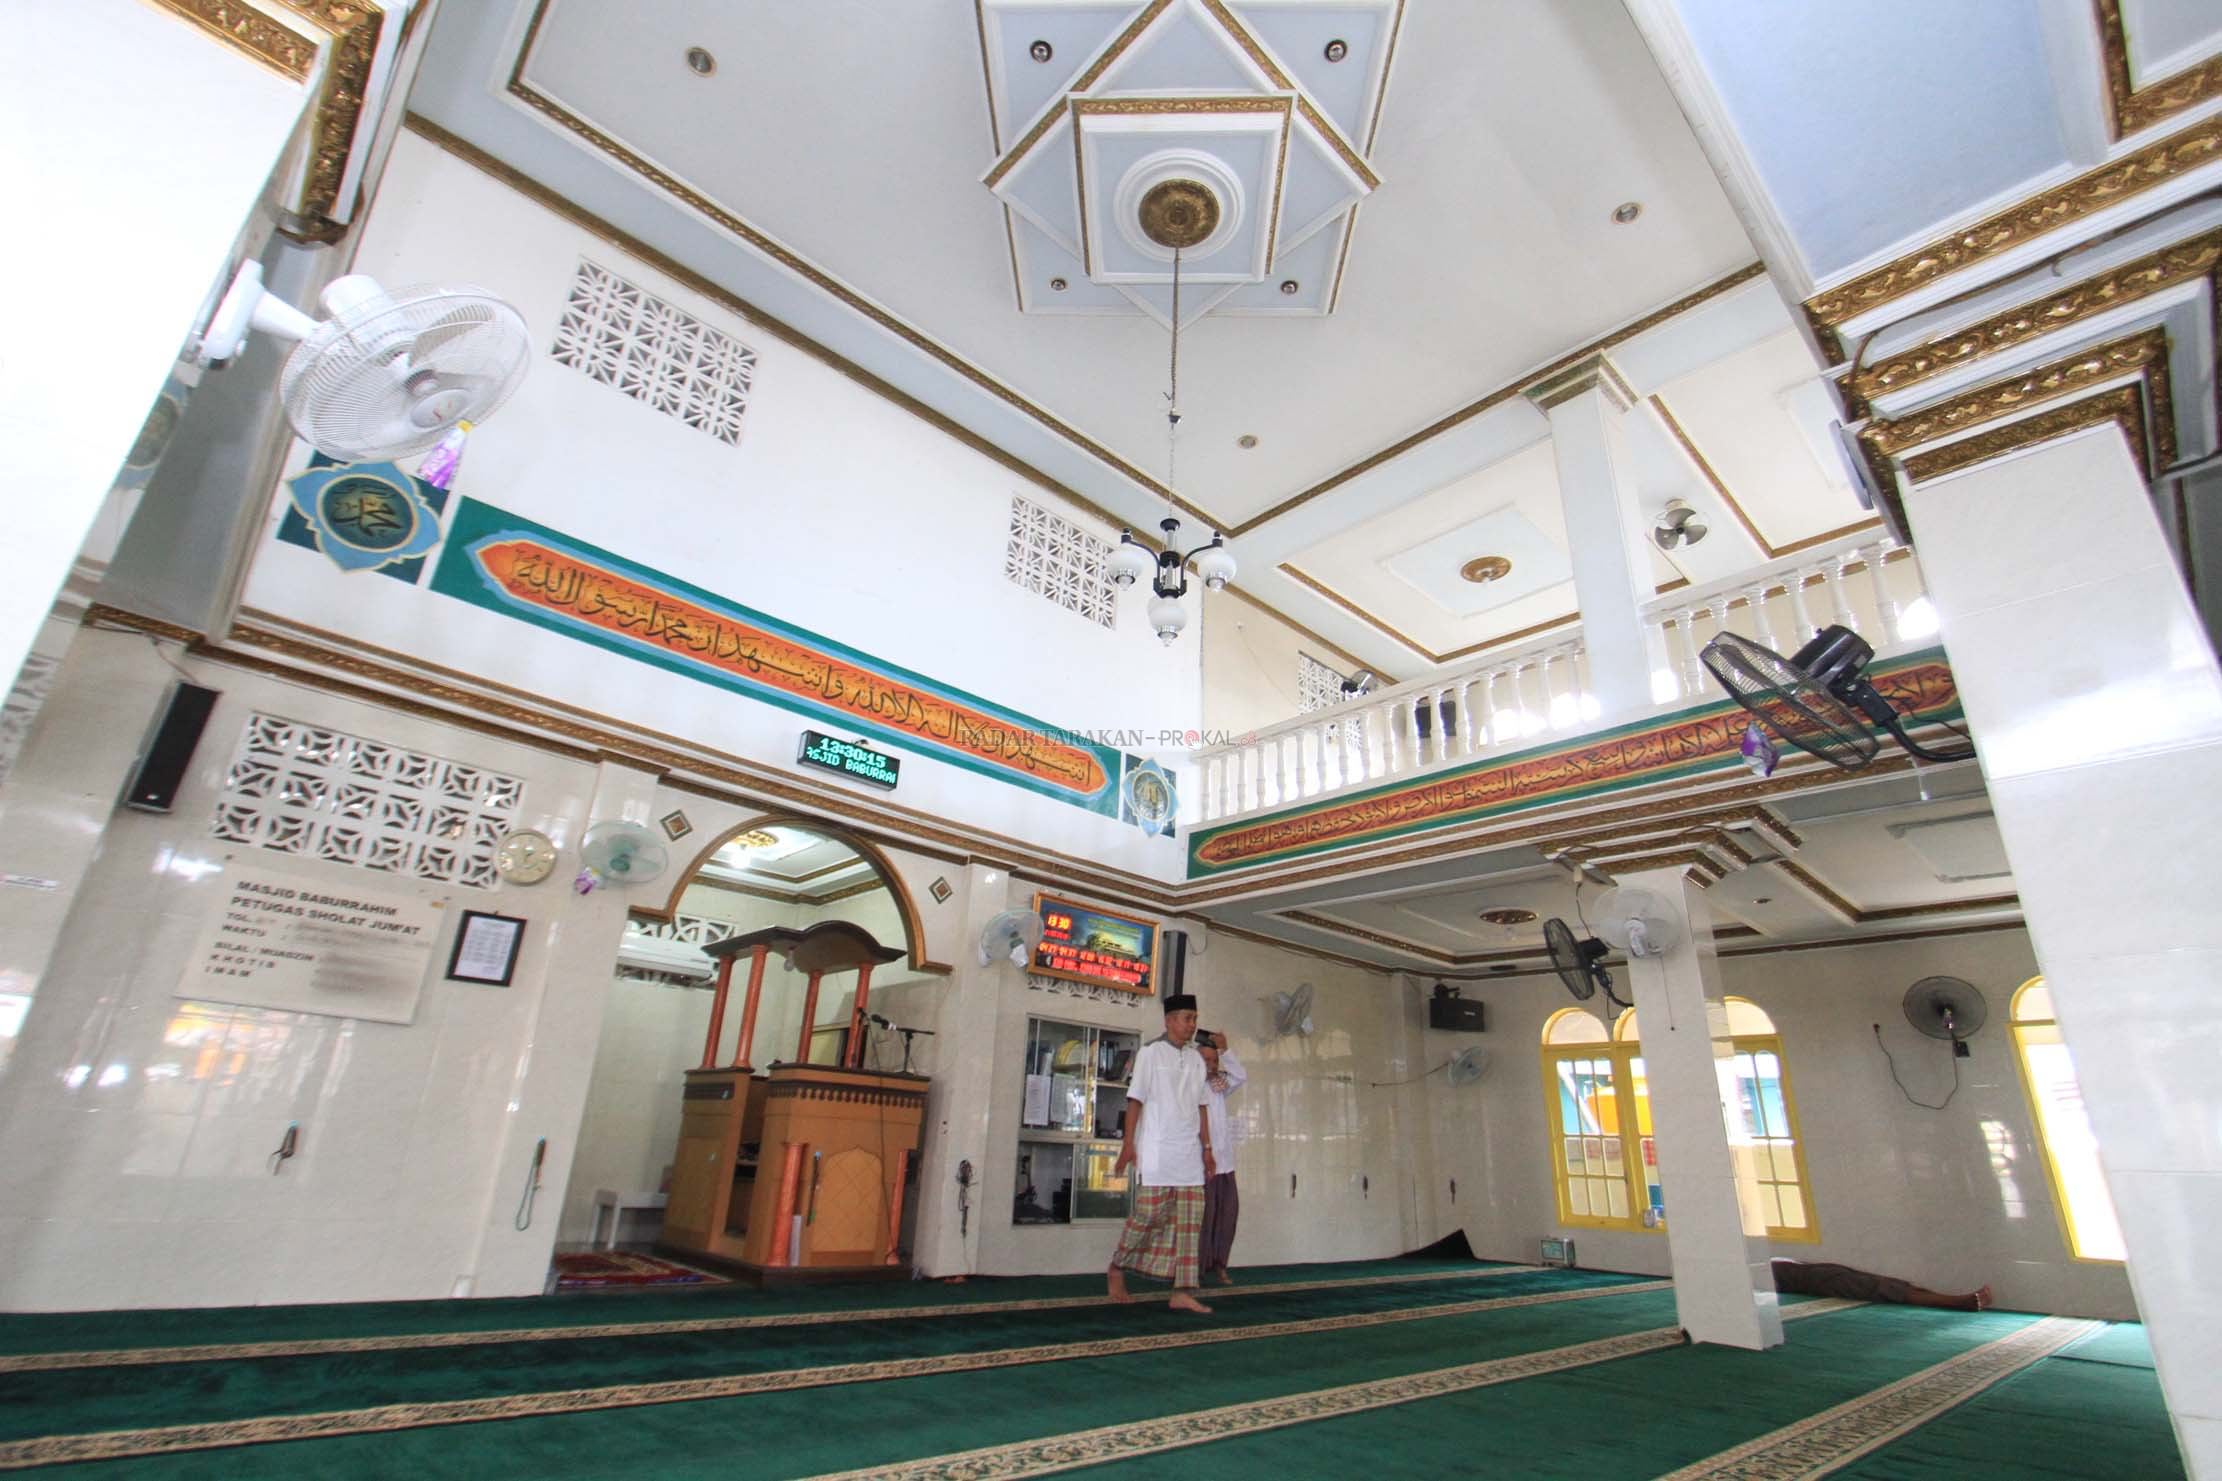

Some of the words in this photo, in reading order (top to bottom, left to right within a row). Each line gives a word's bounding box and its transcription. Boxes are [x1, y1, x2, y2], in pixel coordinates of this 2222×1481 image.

[819, 737, 888, 769] 13:30:15
[230, 896, 304, 917] PETUGAS
[308, 908, 366, 928] SHOLAT
[237, 880, 296, 899] MASJID
[299, 891, 398, 916] BABURRAHIM
